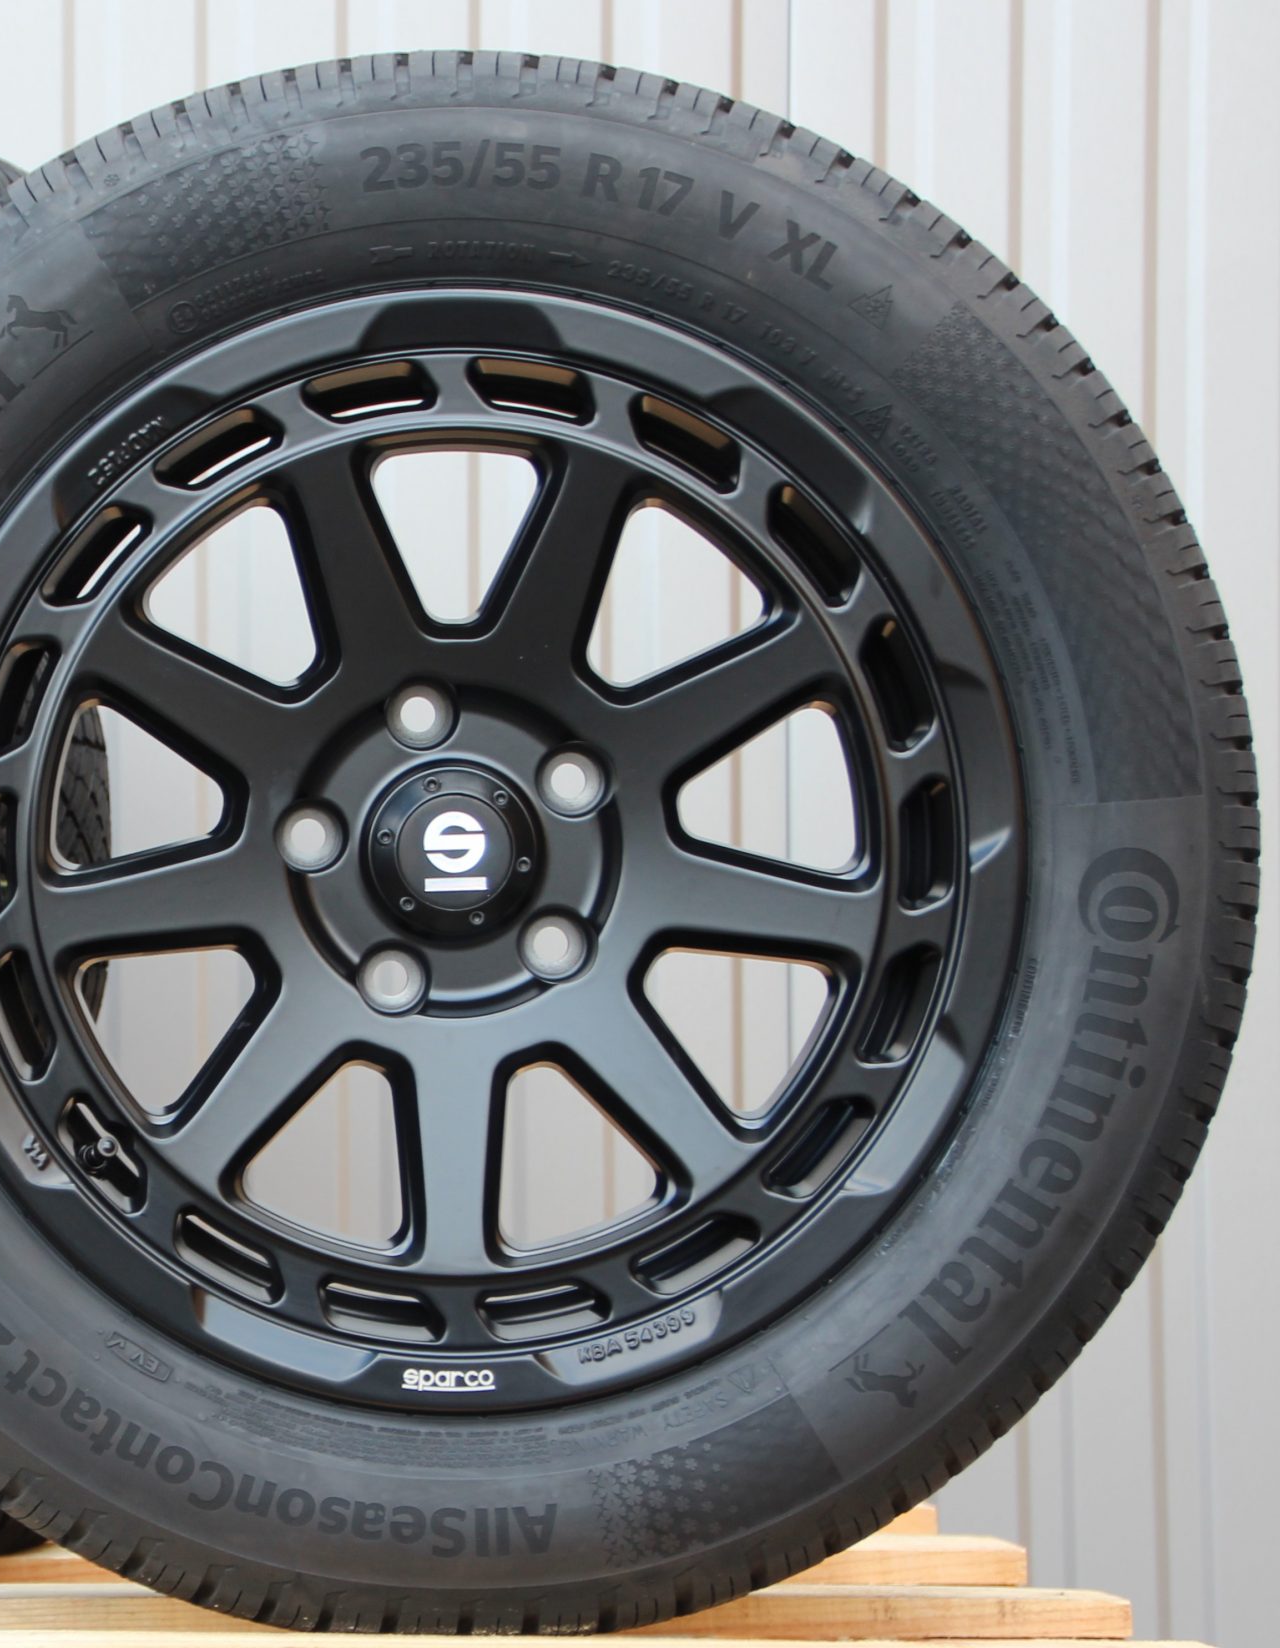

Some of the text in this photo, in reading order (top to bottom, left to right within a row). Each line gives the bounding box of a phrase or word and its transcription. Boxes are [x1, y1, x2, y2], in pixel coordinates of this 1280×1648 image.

[356, 138, 853, 295] 235/55 R 17 V XL
[897, 846, 1180, 1365] Continental
[402, 1367, 495, 1392] sparco
[576, 1309, 697, 1365] KBA 54399
[3, 1349, 559, 1558] AllSeasonContact
